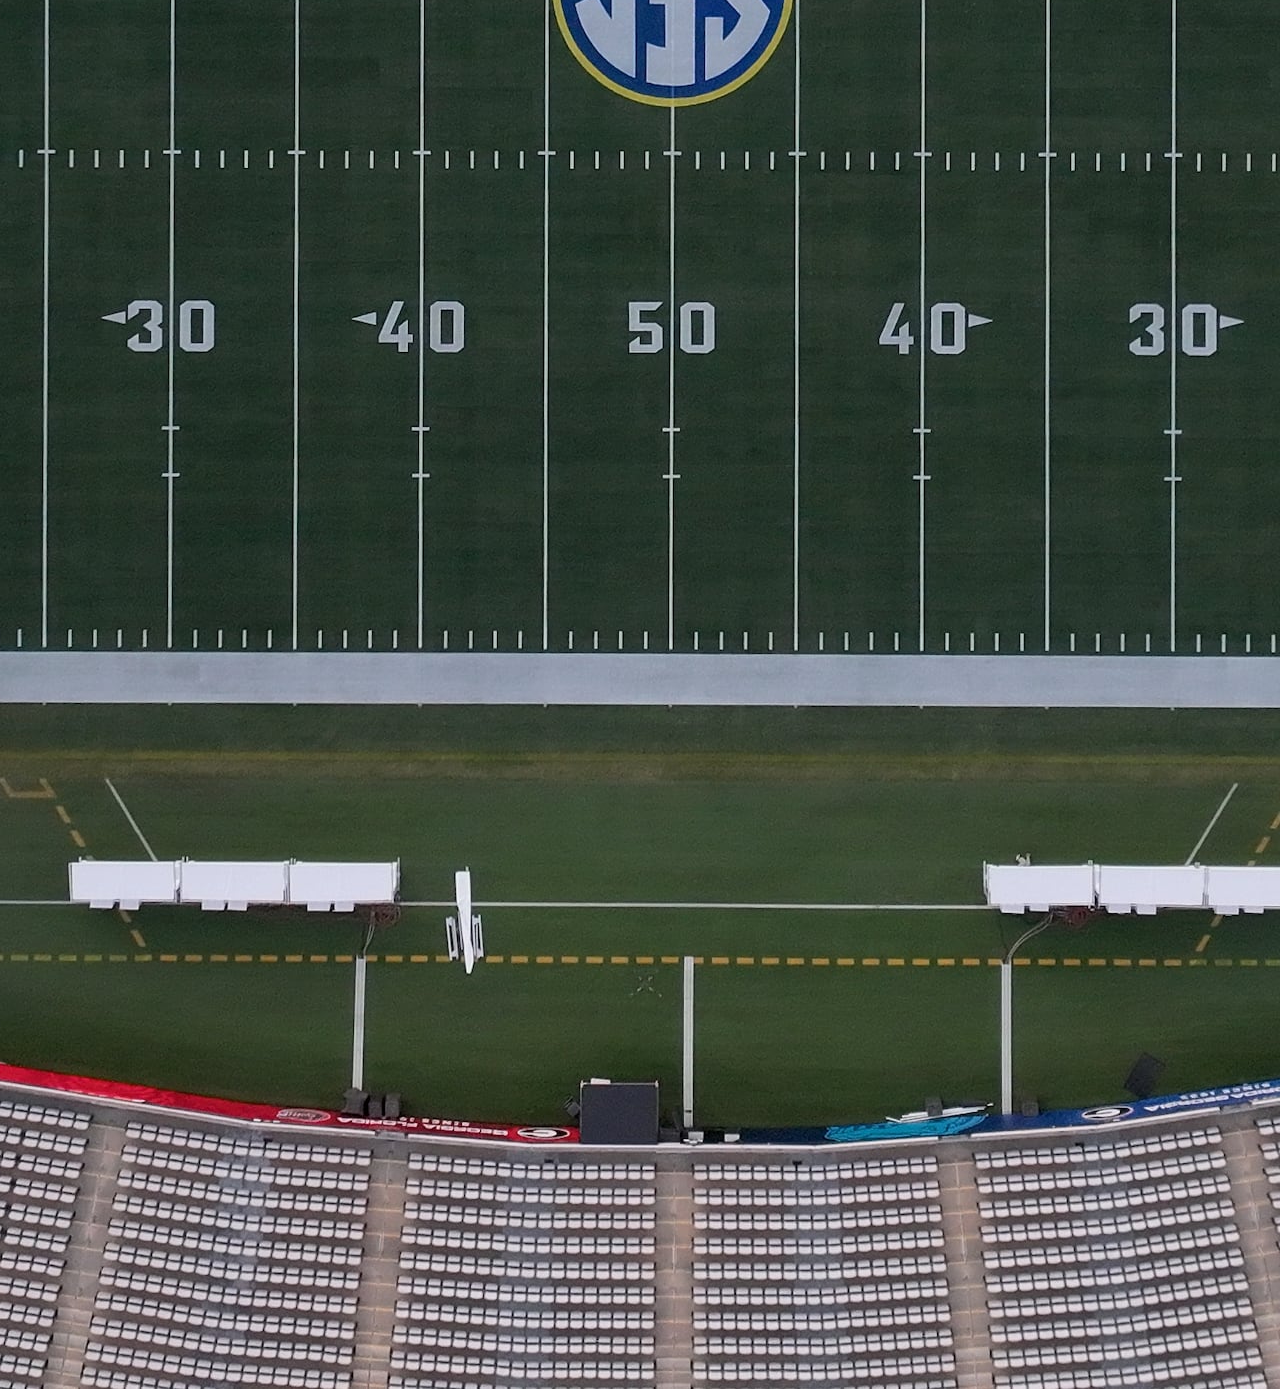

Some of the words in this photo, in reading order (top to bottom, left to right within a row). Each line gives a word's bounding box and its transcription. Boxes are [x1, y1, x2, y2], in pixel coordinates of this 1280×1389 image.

[128, 300, 215, 353] 30
[378, 301, 465, 353] 40
[628, 301, 715, 354] 50
[879, 302, 966, 355] 40
[1130, 303, 1218, 357] 30
[336, 1116, 418, 1129] FLORIDA
[1144, 1094, 1229, 1112] GEORGIA
[422, 1123, 509, 1137] GEORGIA
